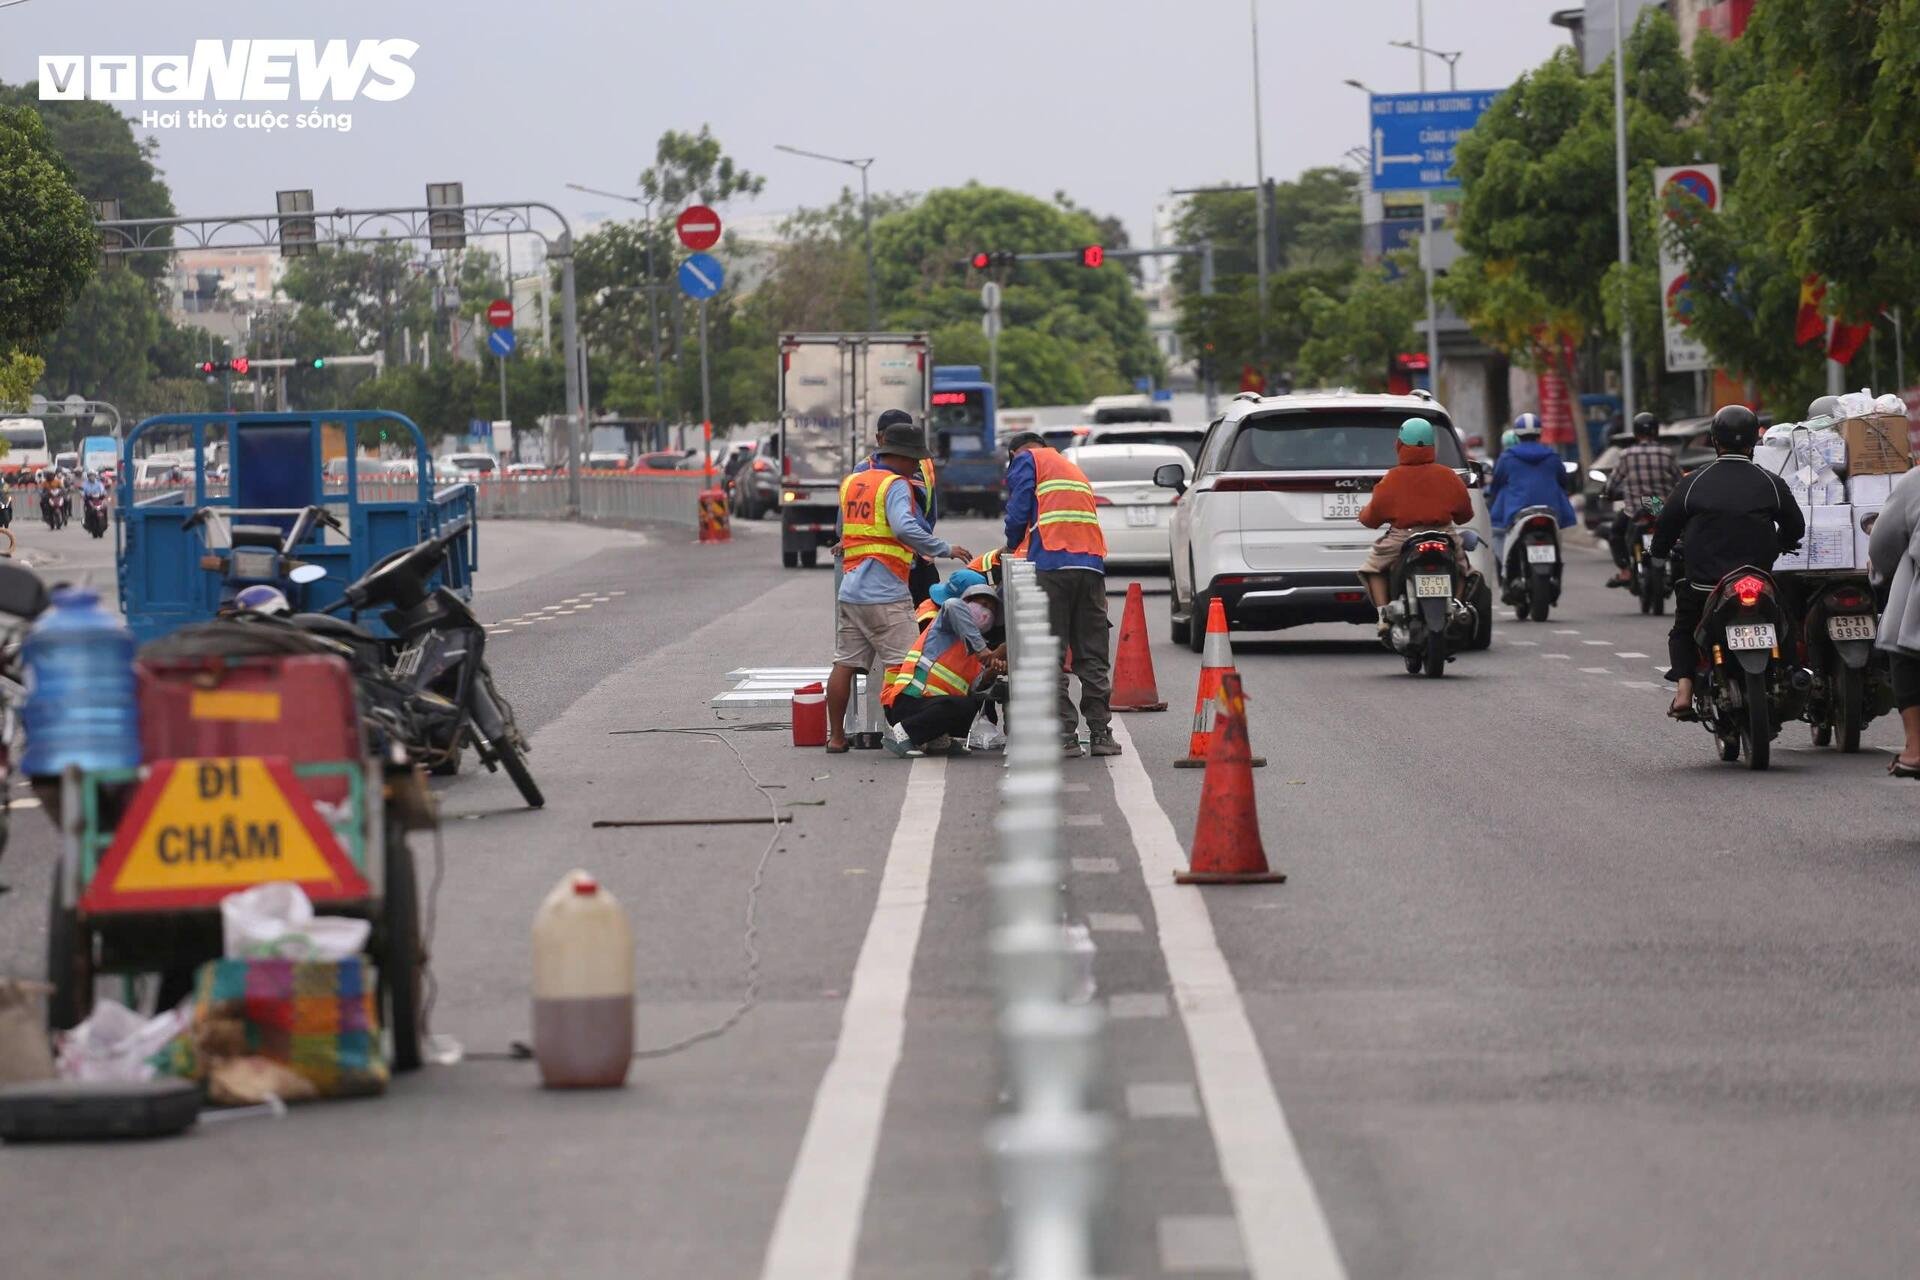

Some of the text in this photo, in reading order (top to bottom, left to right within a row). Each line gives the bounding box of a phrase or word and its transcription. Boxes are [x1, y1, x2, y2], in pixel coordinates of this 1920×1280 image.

[1337, 494, 1359, 505] 51K
[847, 501, 870, 519] TVC
[1731, 636, 1773, 648] 310.63
[198, 759, 241, 799] ĐI
[156, 815, 282, 869] CHẬM
